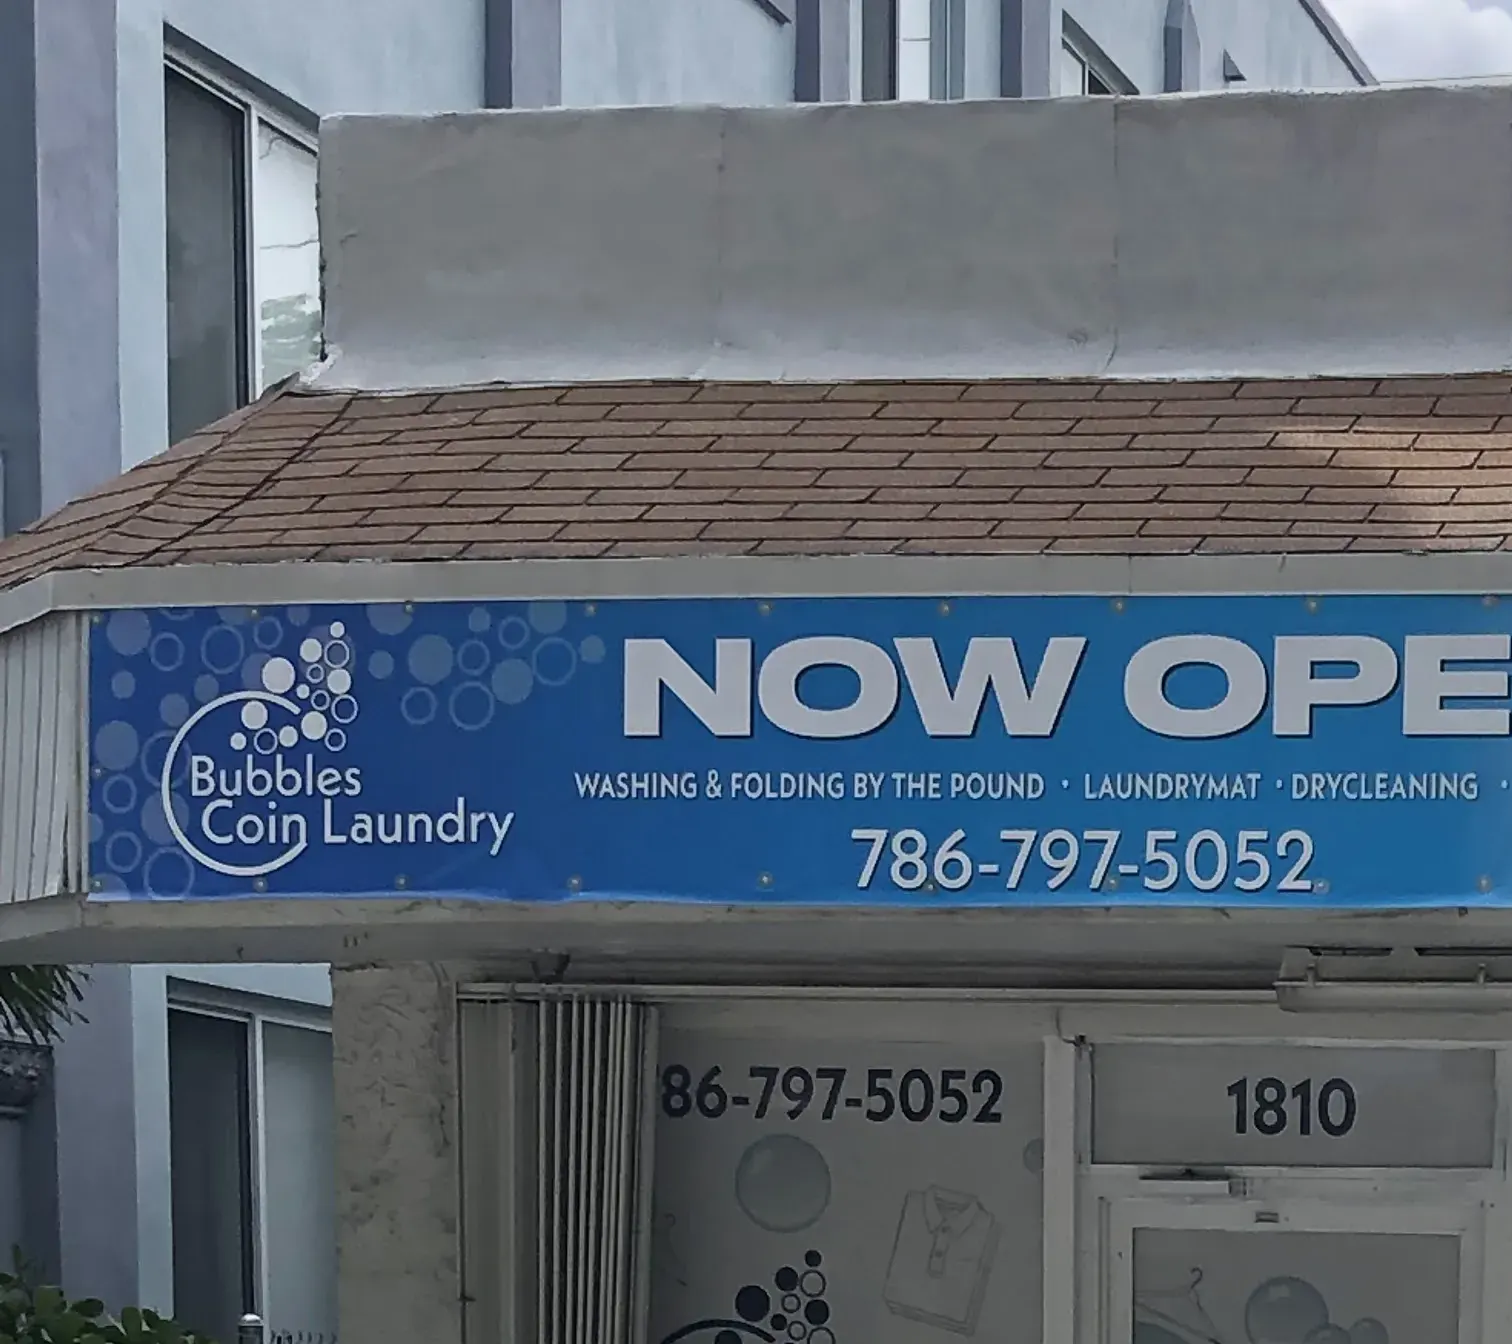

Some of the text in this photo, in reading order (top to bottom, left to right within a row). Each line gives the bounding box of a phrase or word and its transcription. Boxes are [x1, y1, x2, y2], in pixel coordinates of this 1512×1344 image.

[624, 635, 1088, 738] NOW
[189, 754, 362, 797] Bubbles
[575, 771, 698, 799] WASHING
[705, 769, 723, 799] &
[731, 772, 845, 799] FOLDING
[854, 772, 886, 799] BY
[892, 772, 942, 799] THE
[951, 772, 1045, 799] POUND
[1084, 772, 1262, 800] LAUNDRYMAT
[1291, 772, 1479, 801] DRYCLEANING
[201, 797, 515, 857] Coin Laundry
[851, 828, 1315, 893] 786-797-5052
[656, 1063, 1003, 1123] 86-797-5052
[1227, 1076, 1357, 1137] 1810
